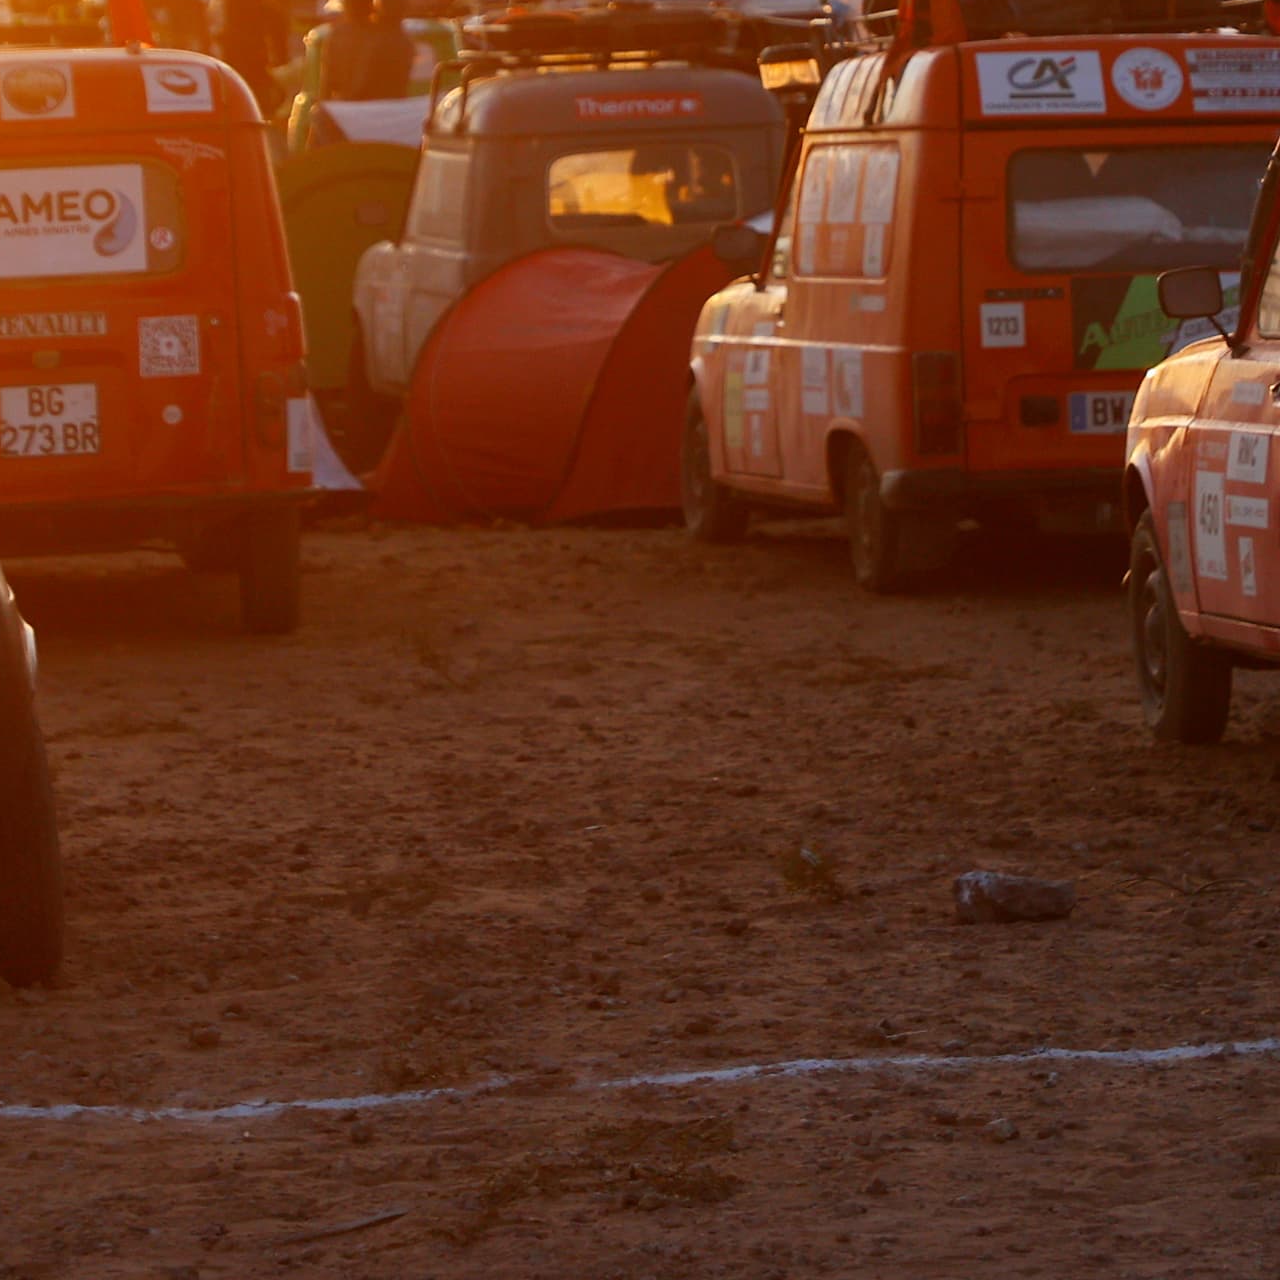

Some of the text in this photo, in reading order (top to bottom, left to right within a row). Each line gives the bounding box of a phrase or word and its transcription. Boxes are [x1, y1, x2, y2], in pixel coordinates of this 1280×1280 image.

[986, 316, 1019, 337] 1213
[28, 387, 65, 417] BG
[0, 422, 99, 455] 273 BR
